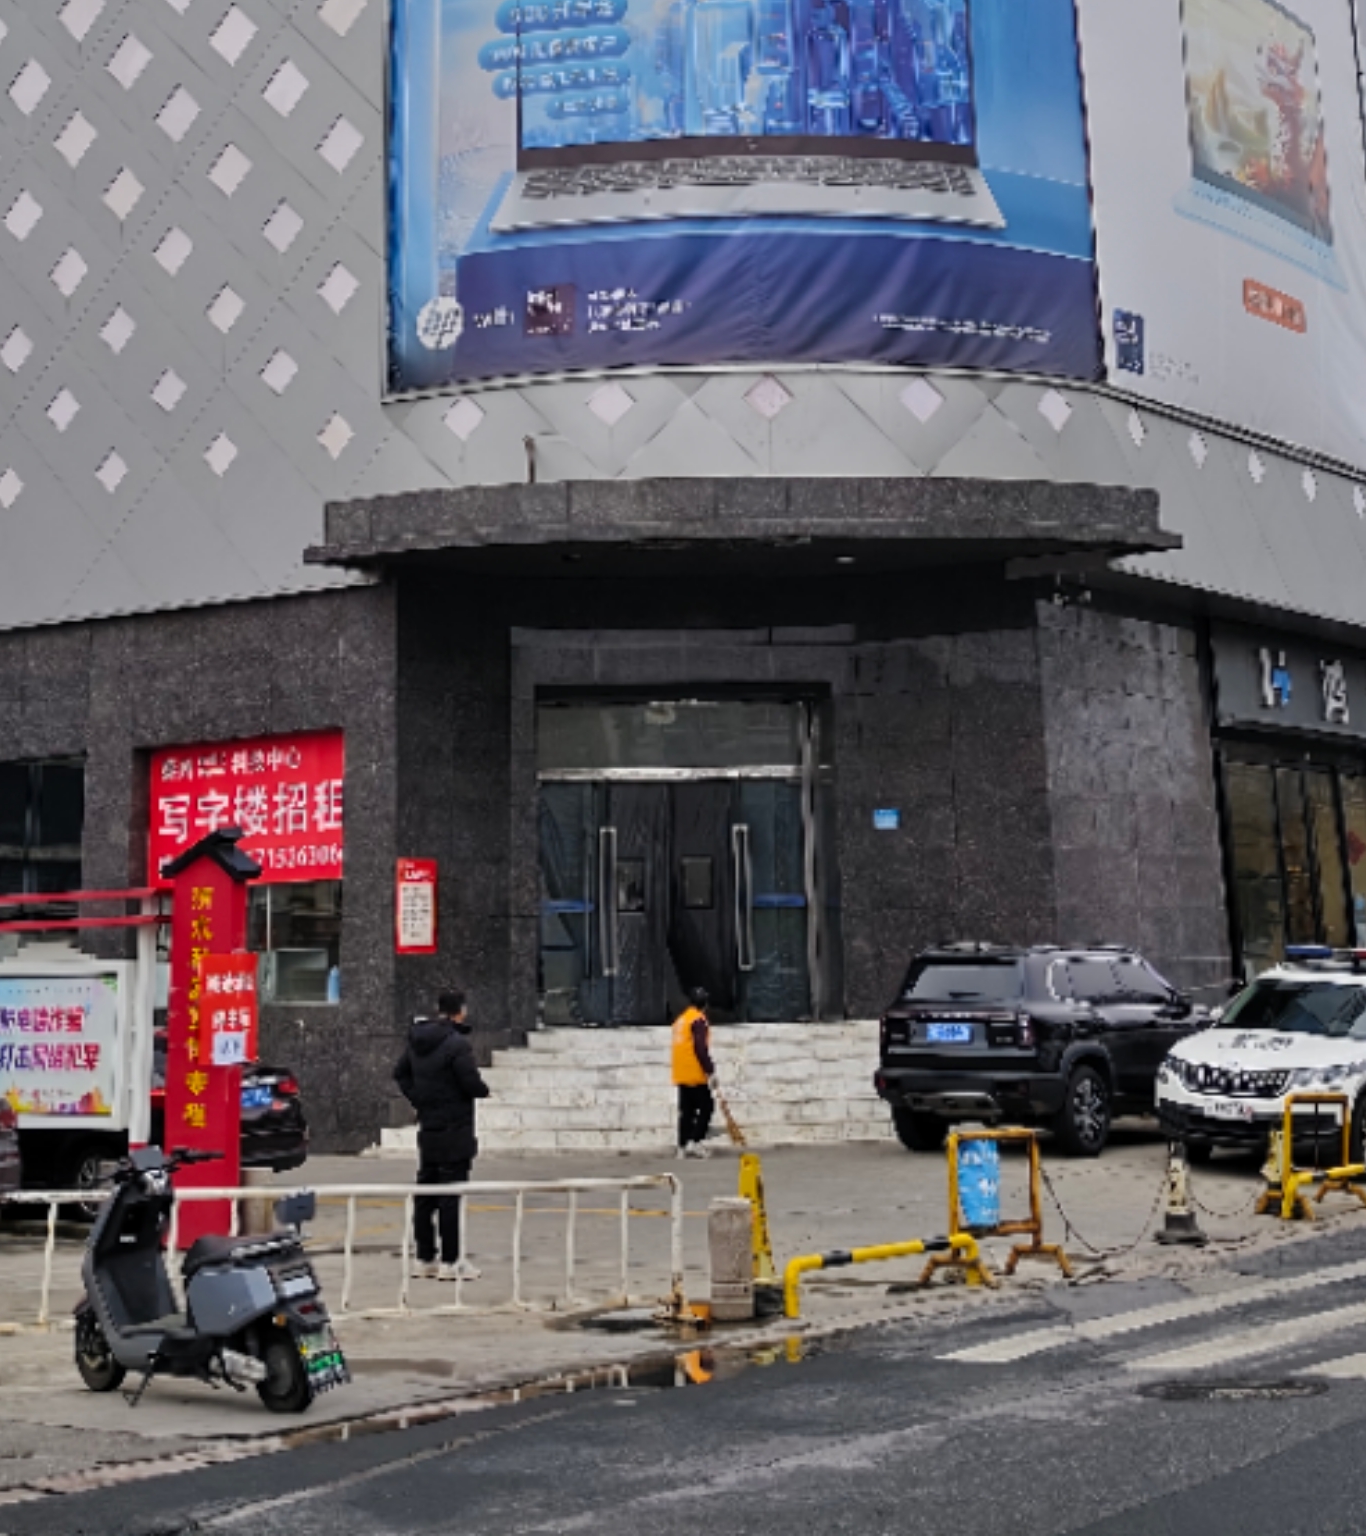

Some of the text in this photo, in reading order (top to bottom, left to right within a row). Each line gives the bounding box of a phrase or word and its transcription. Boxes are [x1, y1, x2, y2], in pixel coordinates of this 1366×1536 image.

[157, 777, 343, 844] 写字楼招租
